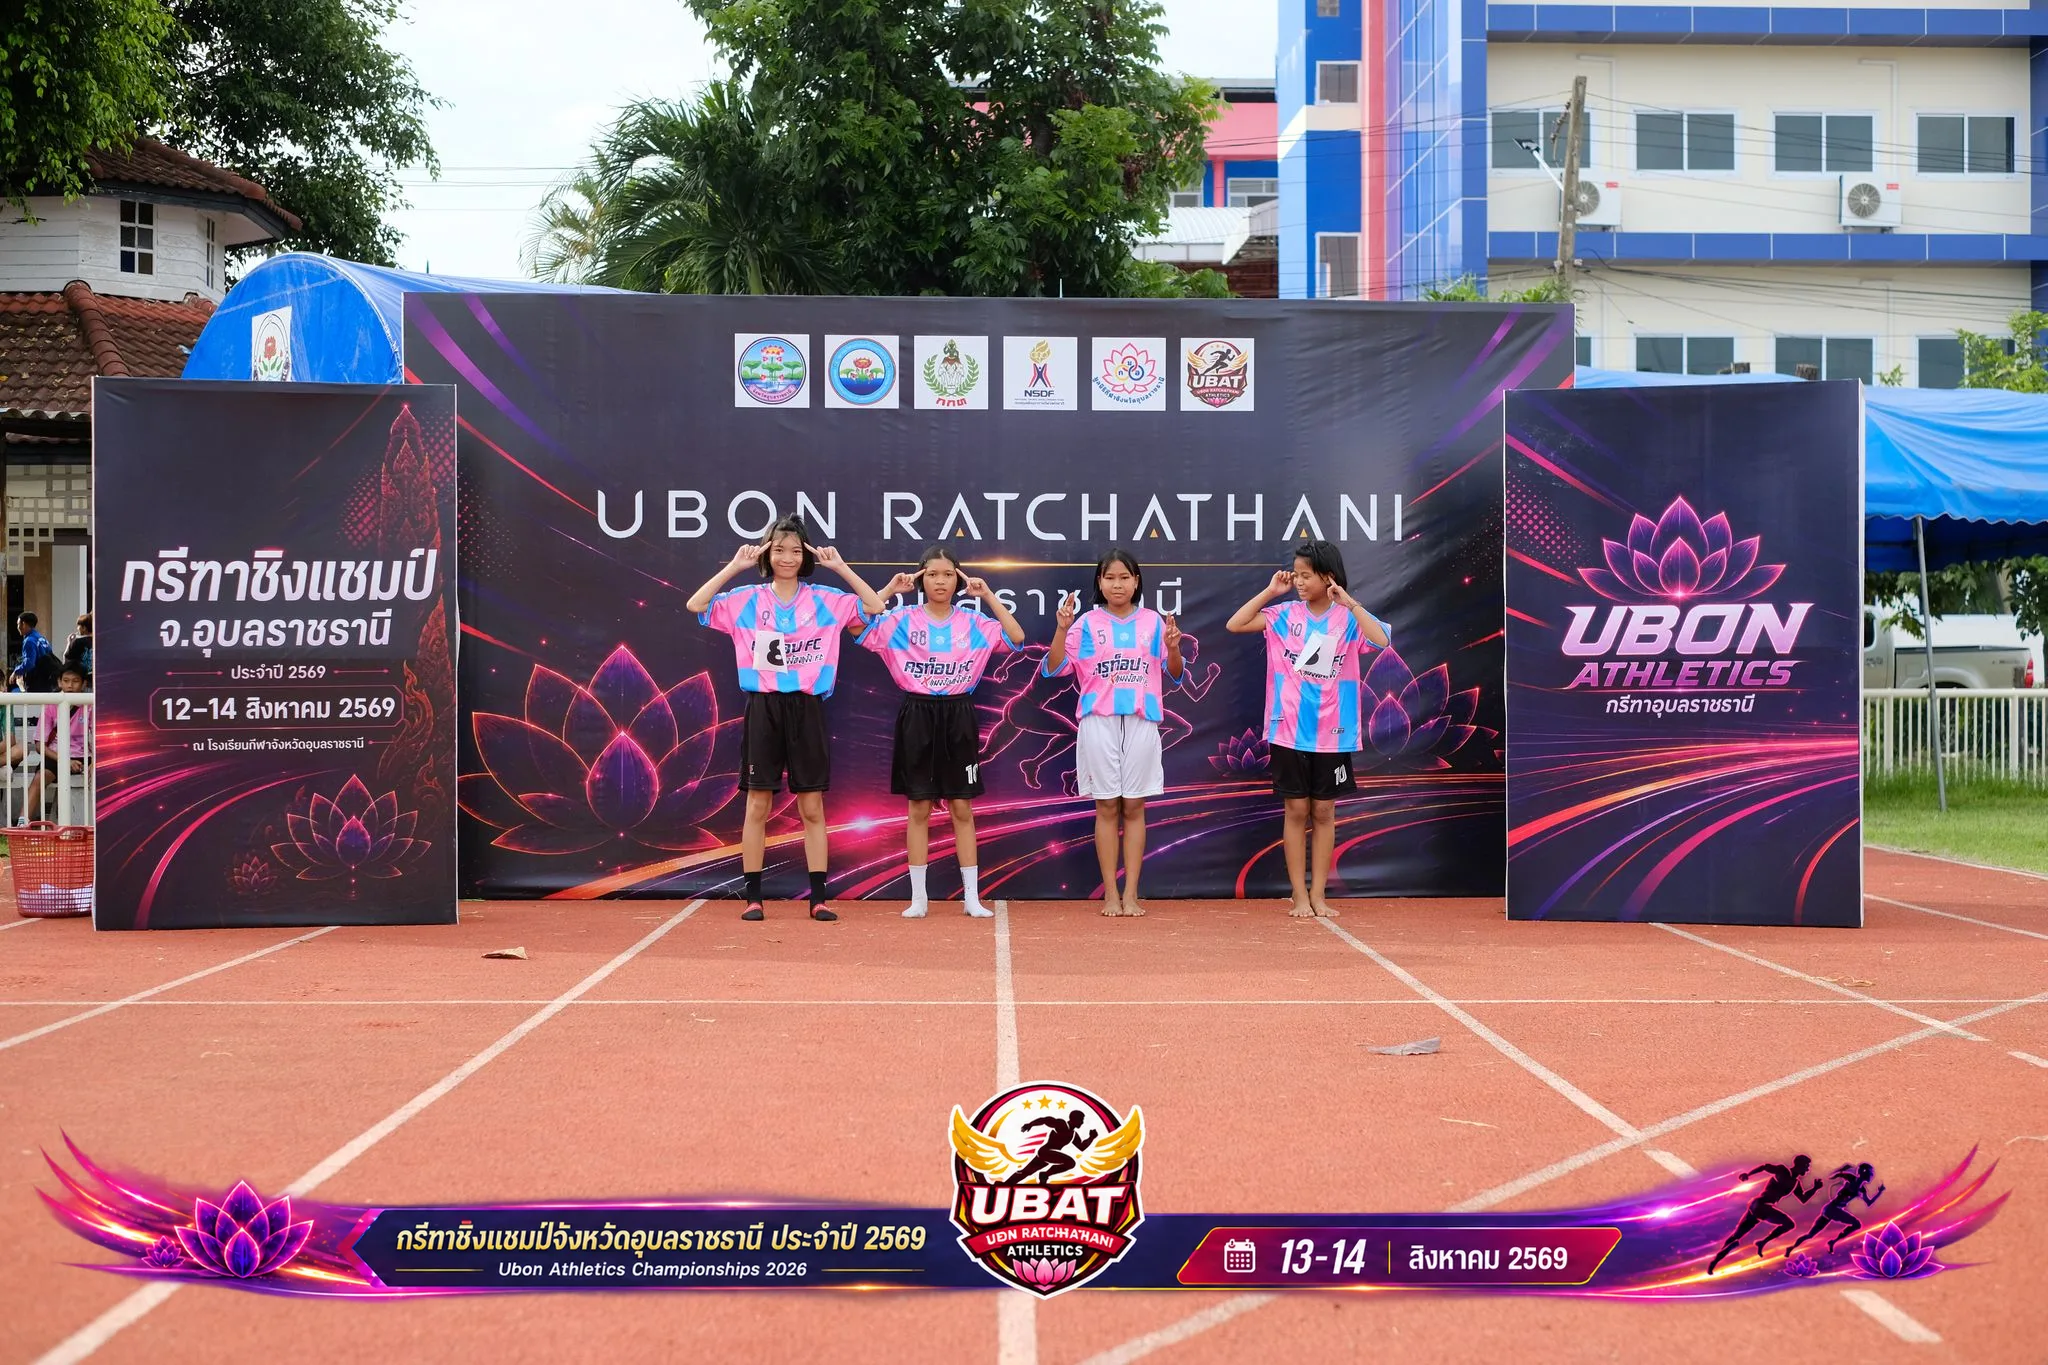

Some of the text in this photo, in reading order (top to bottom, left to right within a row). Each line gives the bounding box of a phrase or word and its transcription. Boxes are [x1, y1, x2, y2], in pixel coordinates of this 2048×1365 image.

[1192, 375, 1244, 388] UBAT
[598, 490, 1403, 542] UBON RATCHATHANI
[120, 546, 438, 602] กรีฑาชิงแชมป์
[160, 609, 393, 658] จ.อุบลราชธานี
[910, 630, 927, 646] 88
[1097, 629, 1107, 645] 5
[1560, 602, 1816, 657] UBON
[804, 638, 822, 652] FC
[231, 664, 327, 680] ประจำปี 2569
[903, 656, 957, 679] ครูท็อป
[1566, 660, 1806, 689] ATHLETICS
[245, 696, 332, 721] สิงหาคม
[338, 696, 396, 719] 2569
[1605, 694, 1757, 718] กรีฑาอุบลราชธานี
[192, 736, 365, 753] ณ โรงเรียนกีฬาจังหวัดอุบลราชธานี
[1334, 764, 1348, 786] 10
